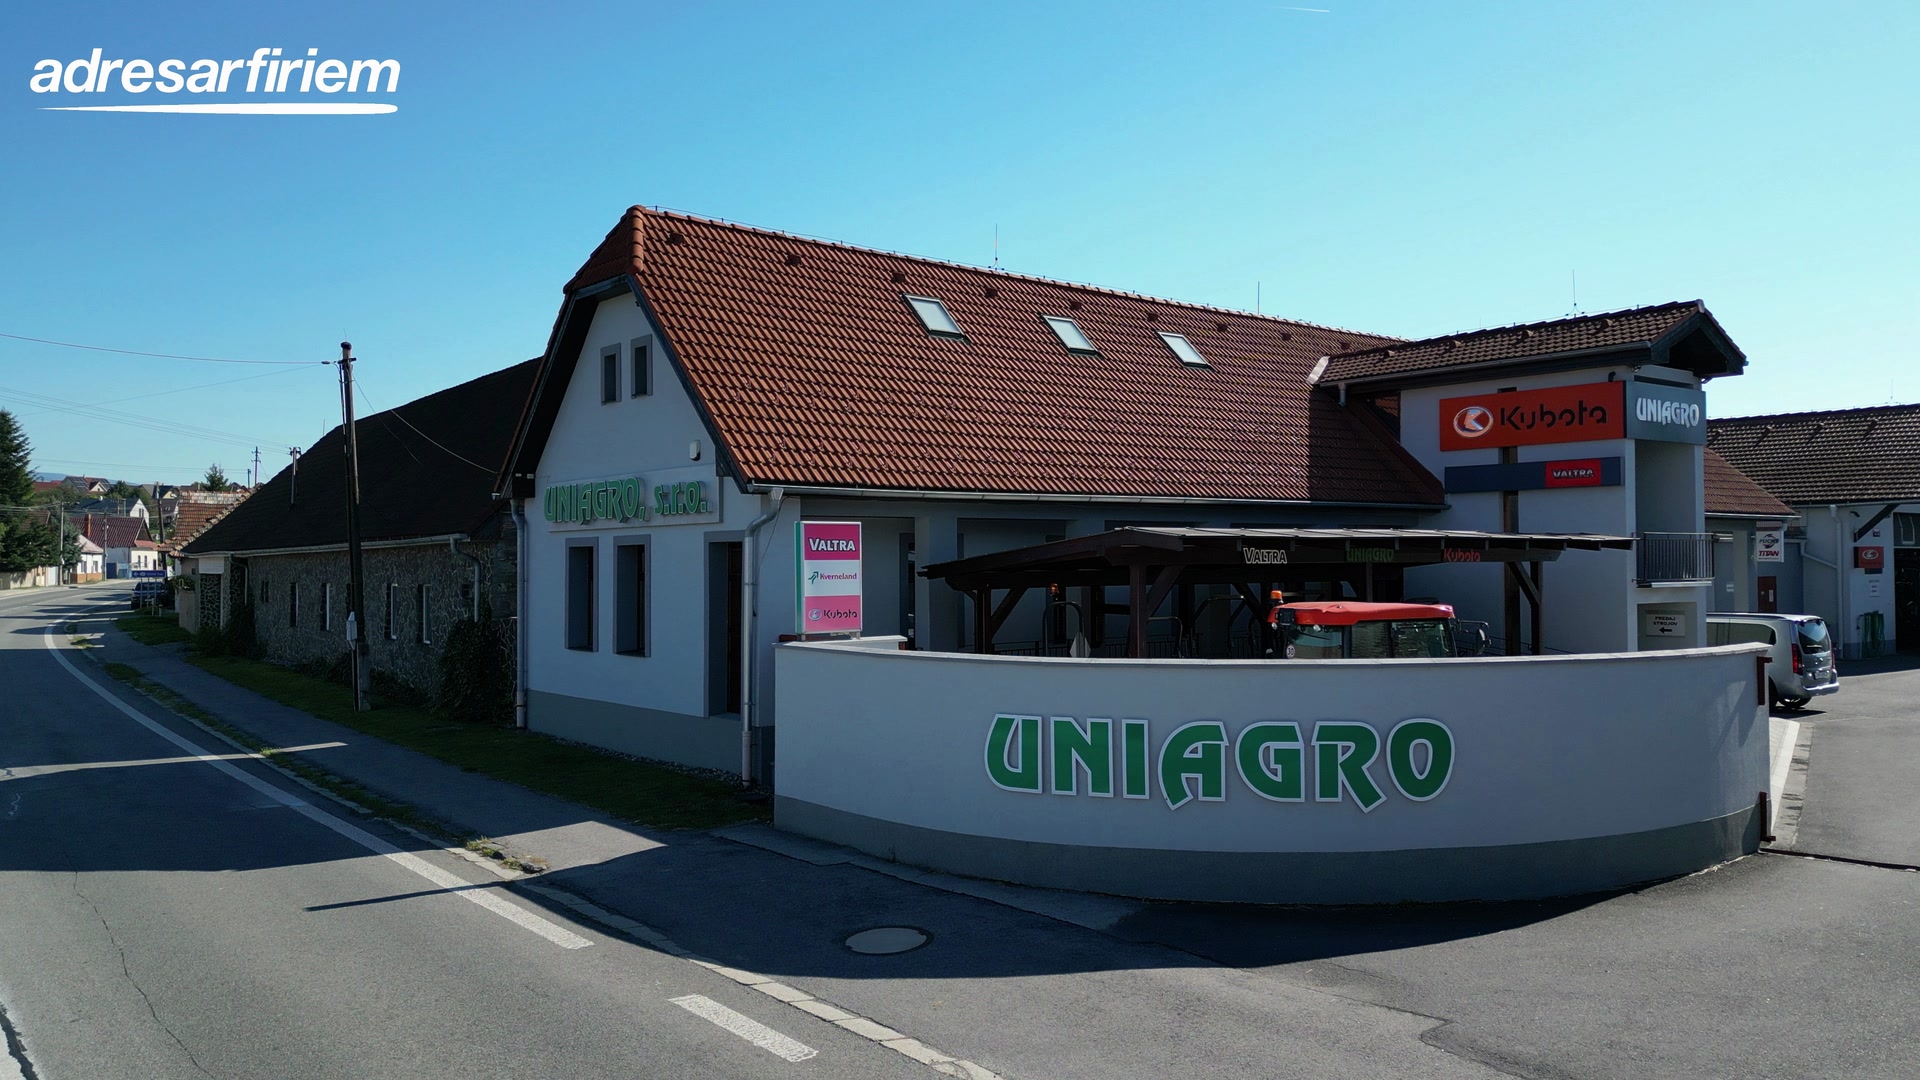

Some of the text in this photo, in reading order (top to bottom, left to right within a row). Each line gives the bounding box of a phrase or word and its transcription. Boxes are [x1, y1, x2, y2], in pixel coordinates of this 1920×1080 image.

[1500, 400, 1608, 431] Kubota
[1635, 397, 1700, 429] UNIAGRO
[1551, 469, 1595, 478] VALTRA
[543, 476, 708, 526] UNIAGRO, s.r.o.
[808, 538, 856, 551] VALTRA
[1243, 547, 1288, 564] VALTRA
[1346, 547, 1394, 562] UNIAGRO
[1443, 547, 1481, 562] Kubota
[820, 572, 857, 580] Kverneland
[823, 609, 858, 619] Kubota
[984, 713, 1456, 814] UNIAGRO
